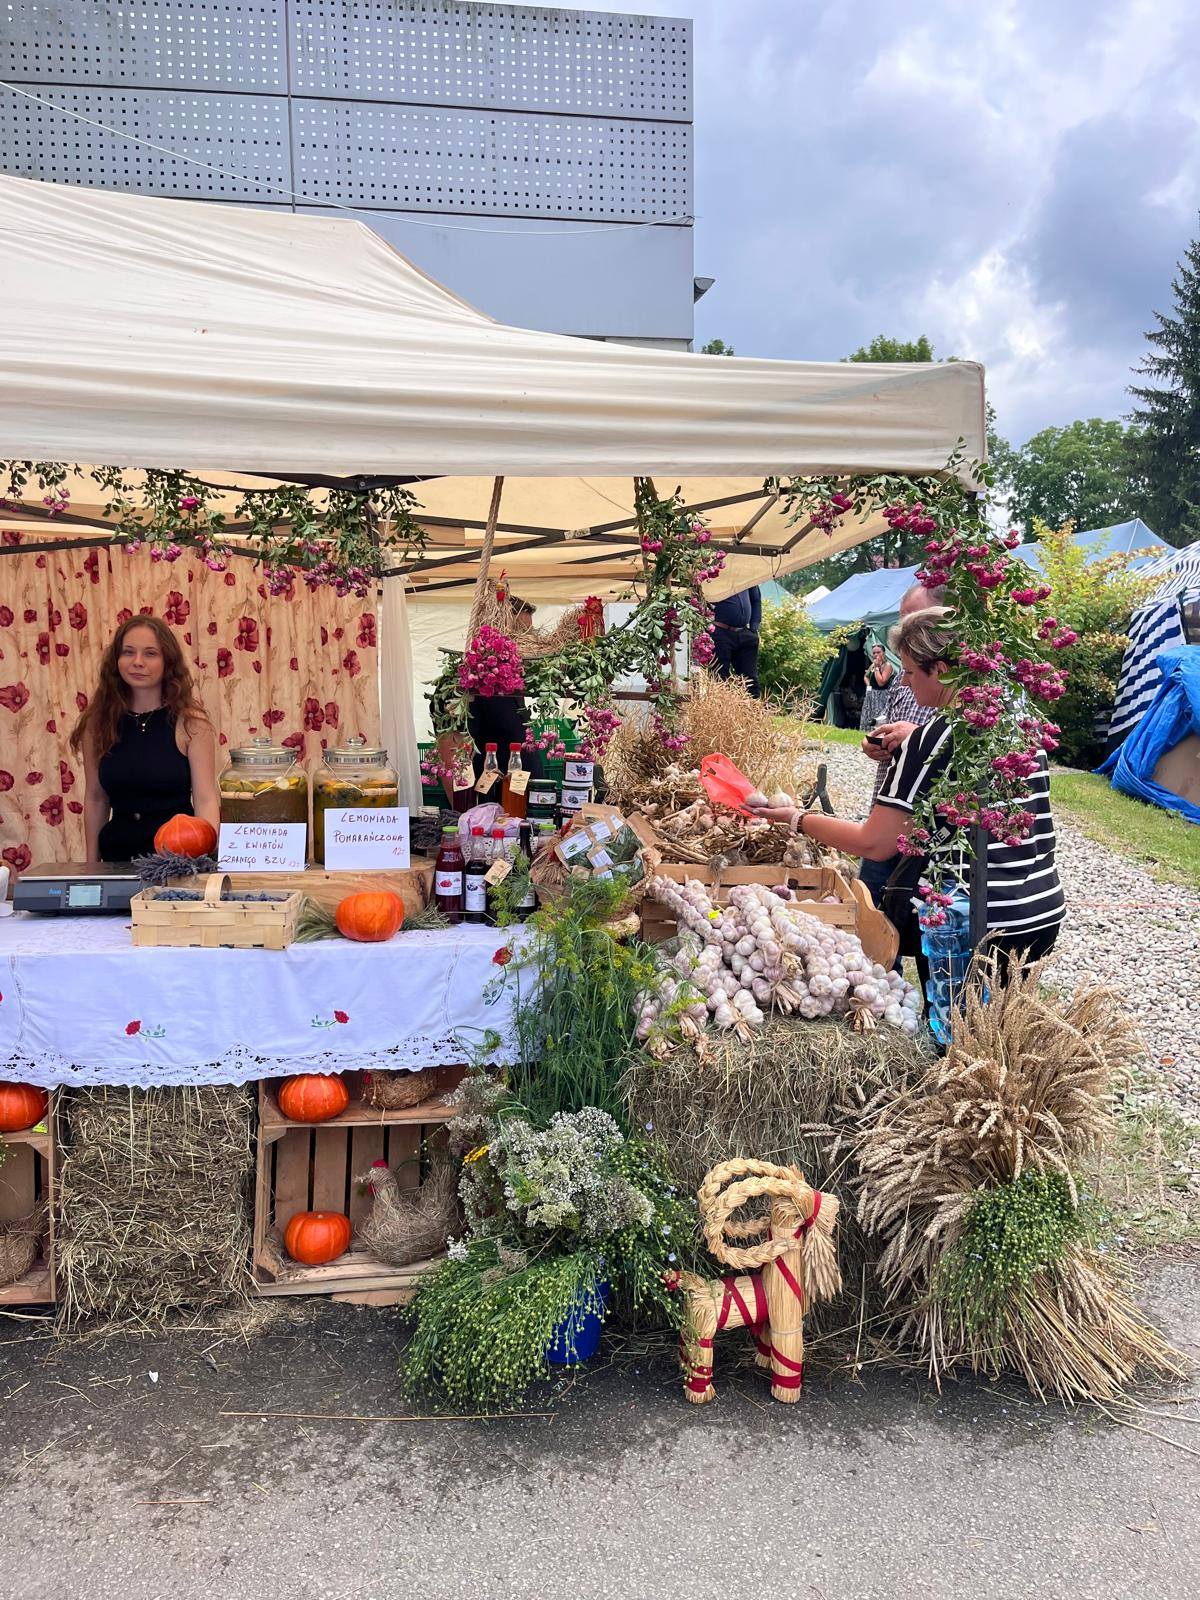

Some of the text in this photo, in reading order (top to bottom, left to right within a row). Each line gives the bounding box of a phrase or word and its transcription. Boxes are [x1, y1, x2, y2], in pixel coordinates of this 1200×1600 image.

[341, 812, 399, 824] LEMONIADA
[234, 825, 288, 837] LEMONIADA
[264, 855, 286, 865] BZU
